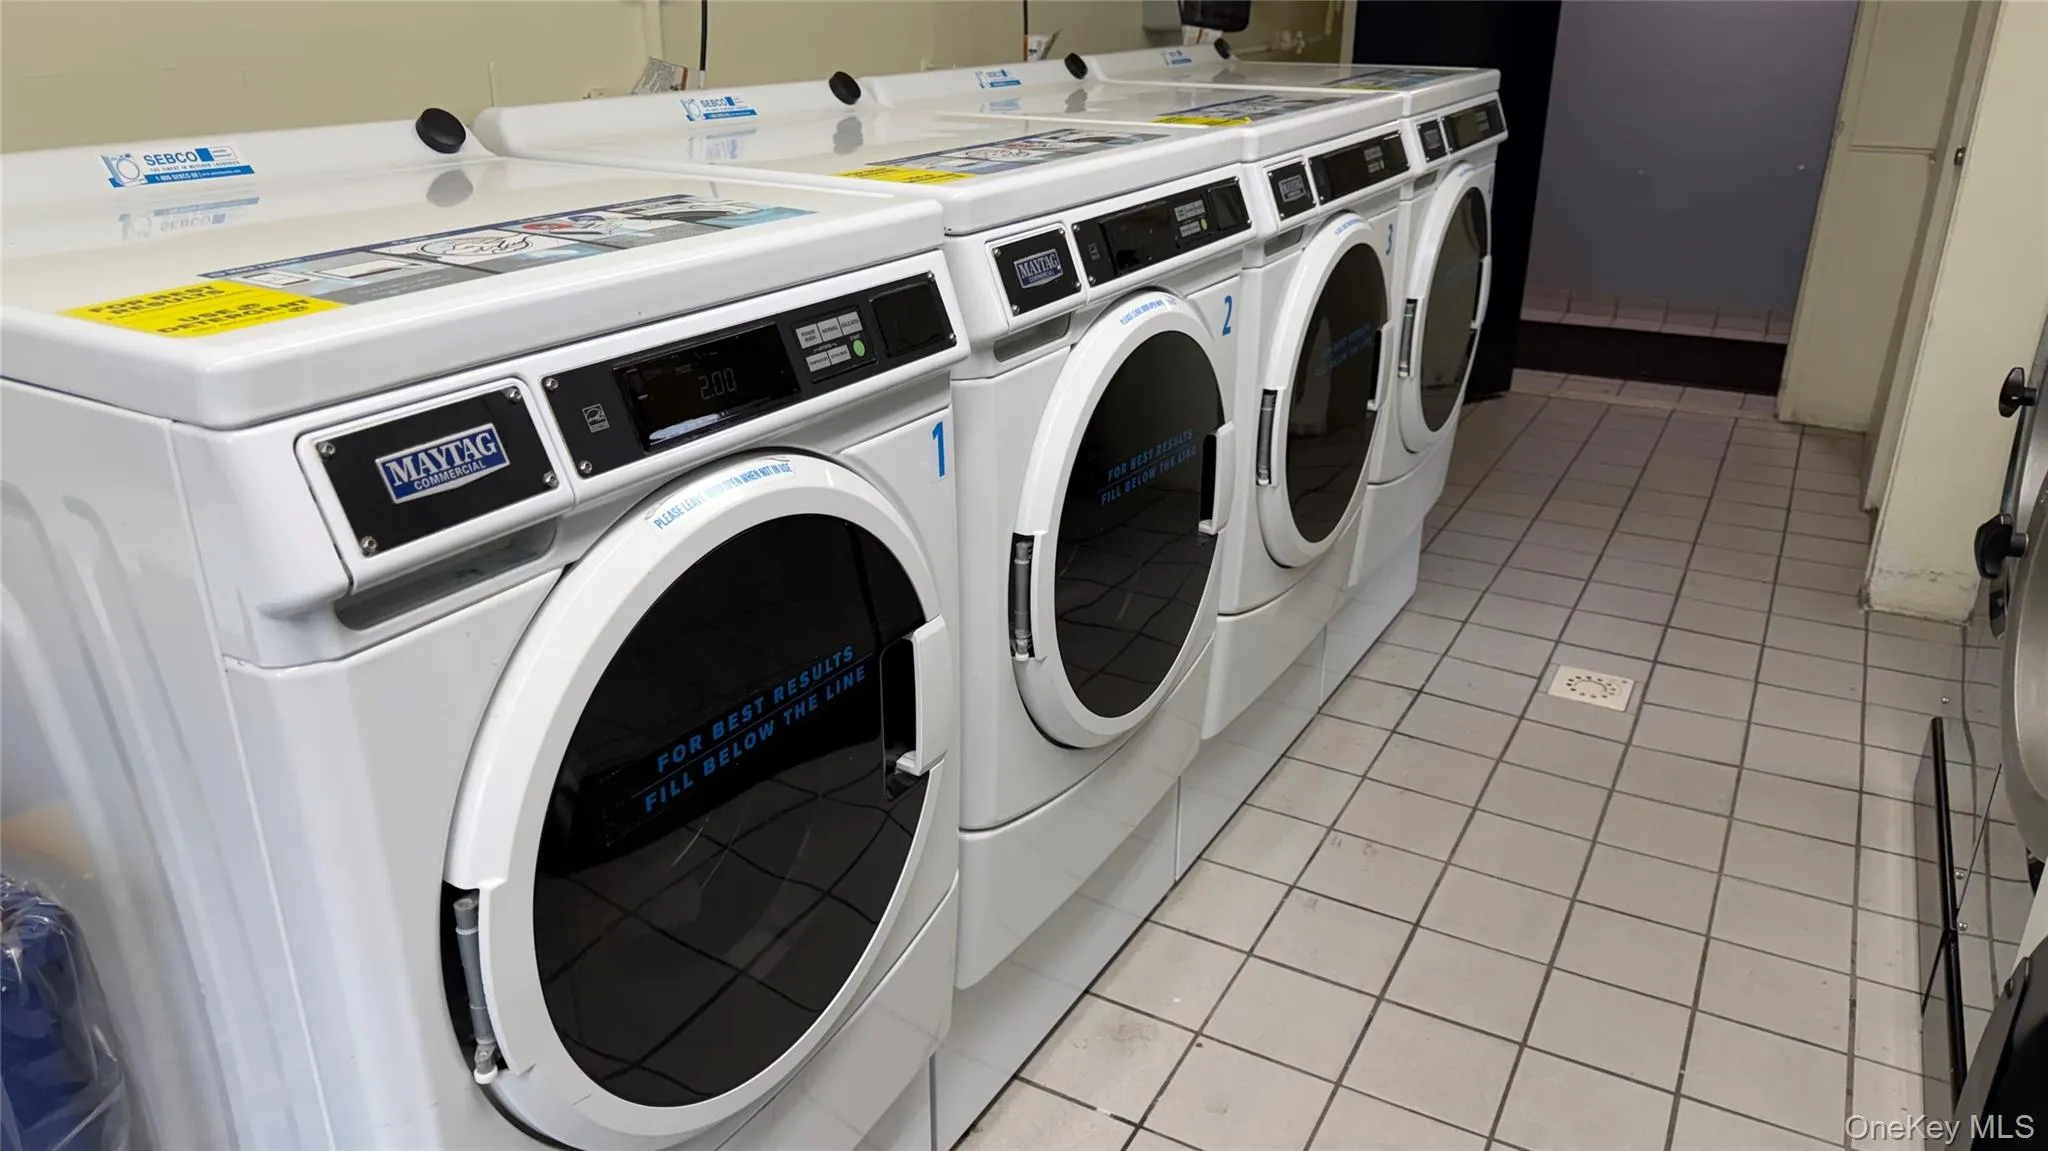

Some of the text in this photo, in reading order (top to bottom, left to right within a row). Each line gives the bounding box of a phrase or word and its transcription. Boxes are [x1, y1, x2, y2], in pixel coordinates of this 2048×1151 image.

[143, 151, 198, 166] SEBCO
[1386, 223, 1394, 256] 3
[1018, 253, 1058, 280] MAYTAG
[89, 298, 143, 313] FOR
[152, 285, 215, 304] BEST
[111, 289, 225, 315] RESULTS
[156, 298, 308, 334] DETERGENT
[178, 308, 229, 322] USE
[1222, 295, 1232, 336] 2
[698, 368, 737, 400] 2.00
[386, 432, 497, 486] MAYTAG
[931, 420, 946, 478] 1
[1108, 428, 1193, 482] FOR BEST RESULTS
[414, 460, 486, 490] COMMERCIAL
[1101, 444, 1196, 506] FILL BELOW THE LINE
[654, 506, 684, 530] PLEASE
[722, 476, 743, 490] OPEN
[740, 470, 763, 484] WHEN
[758, 466, 774, 478] NOT
[772, 464, 782, 475] IN
[780, 462, 792, 473] USE
[656, 646, 854, 773] FOR BEST RESULTS
[645, 665, 866, 814] FILL BELOW THE LINE
